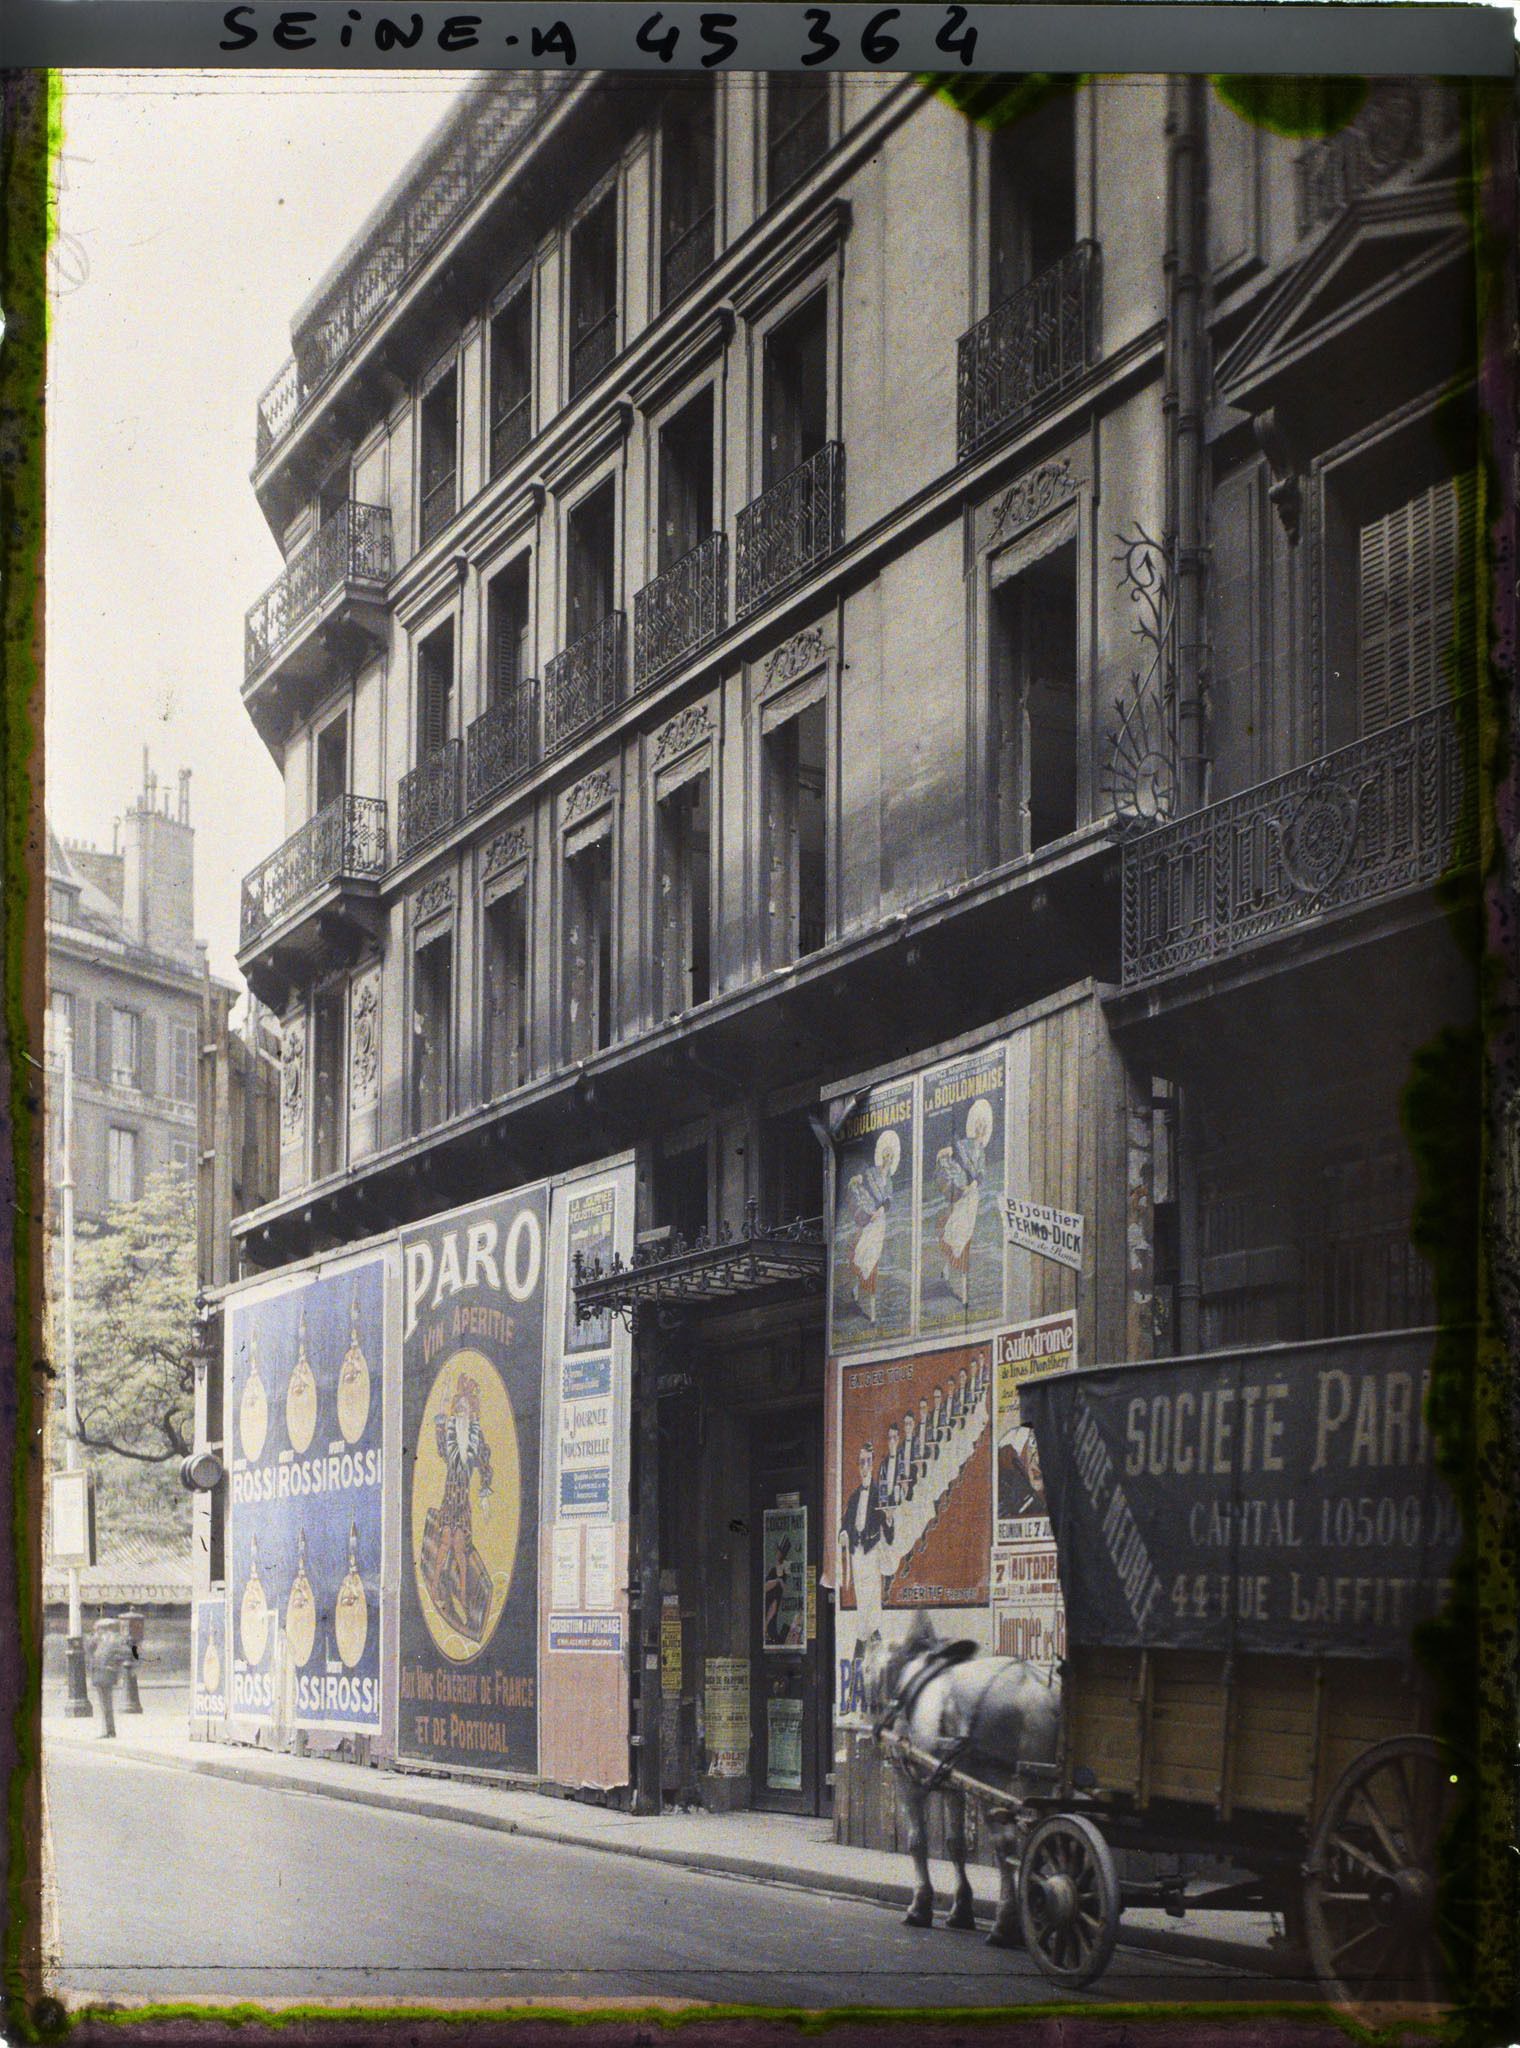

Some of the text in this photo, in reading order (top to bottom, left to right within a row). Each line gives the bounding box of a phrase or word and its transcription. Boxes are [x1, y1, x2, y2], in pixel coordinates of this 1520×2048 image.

[635, 12, 739, 67] 45
[935, 1065, 1004, 1110] BOULONNAISE
[1007, 1198, 1080, 1229] Bijoutier
[404, 1210, 542, 1343] PARO
[998, 1326, 1073, 1364] l'autodrome
[1124, 1371, 1291, 1477] SOCIÉTÉ
[233, 1466, 276, 1504] ROSSI
[278, 1458, 327, 1498] ROSSI
[329, 1448, 382, 1491] ROSSI
[1033, 1521, 1041, 1537] 7
[996, 1563, 1005, 1584] 7
[1171, 1573, 1208, 1618] 44
[1289, 1571, 1454, 1628] LAFFITE
[326, 1676, 379, 1713] ROSSI
[495, 1668, 534, 1707] FRANCE
[416, 1711, 510, 1754] ET DE PORTUGAL
